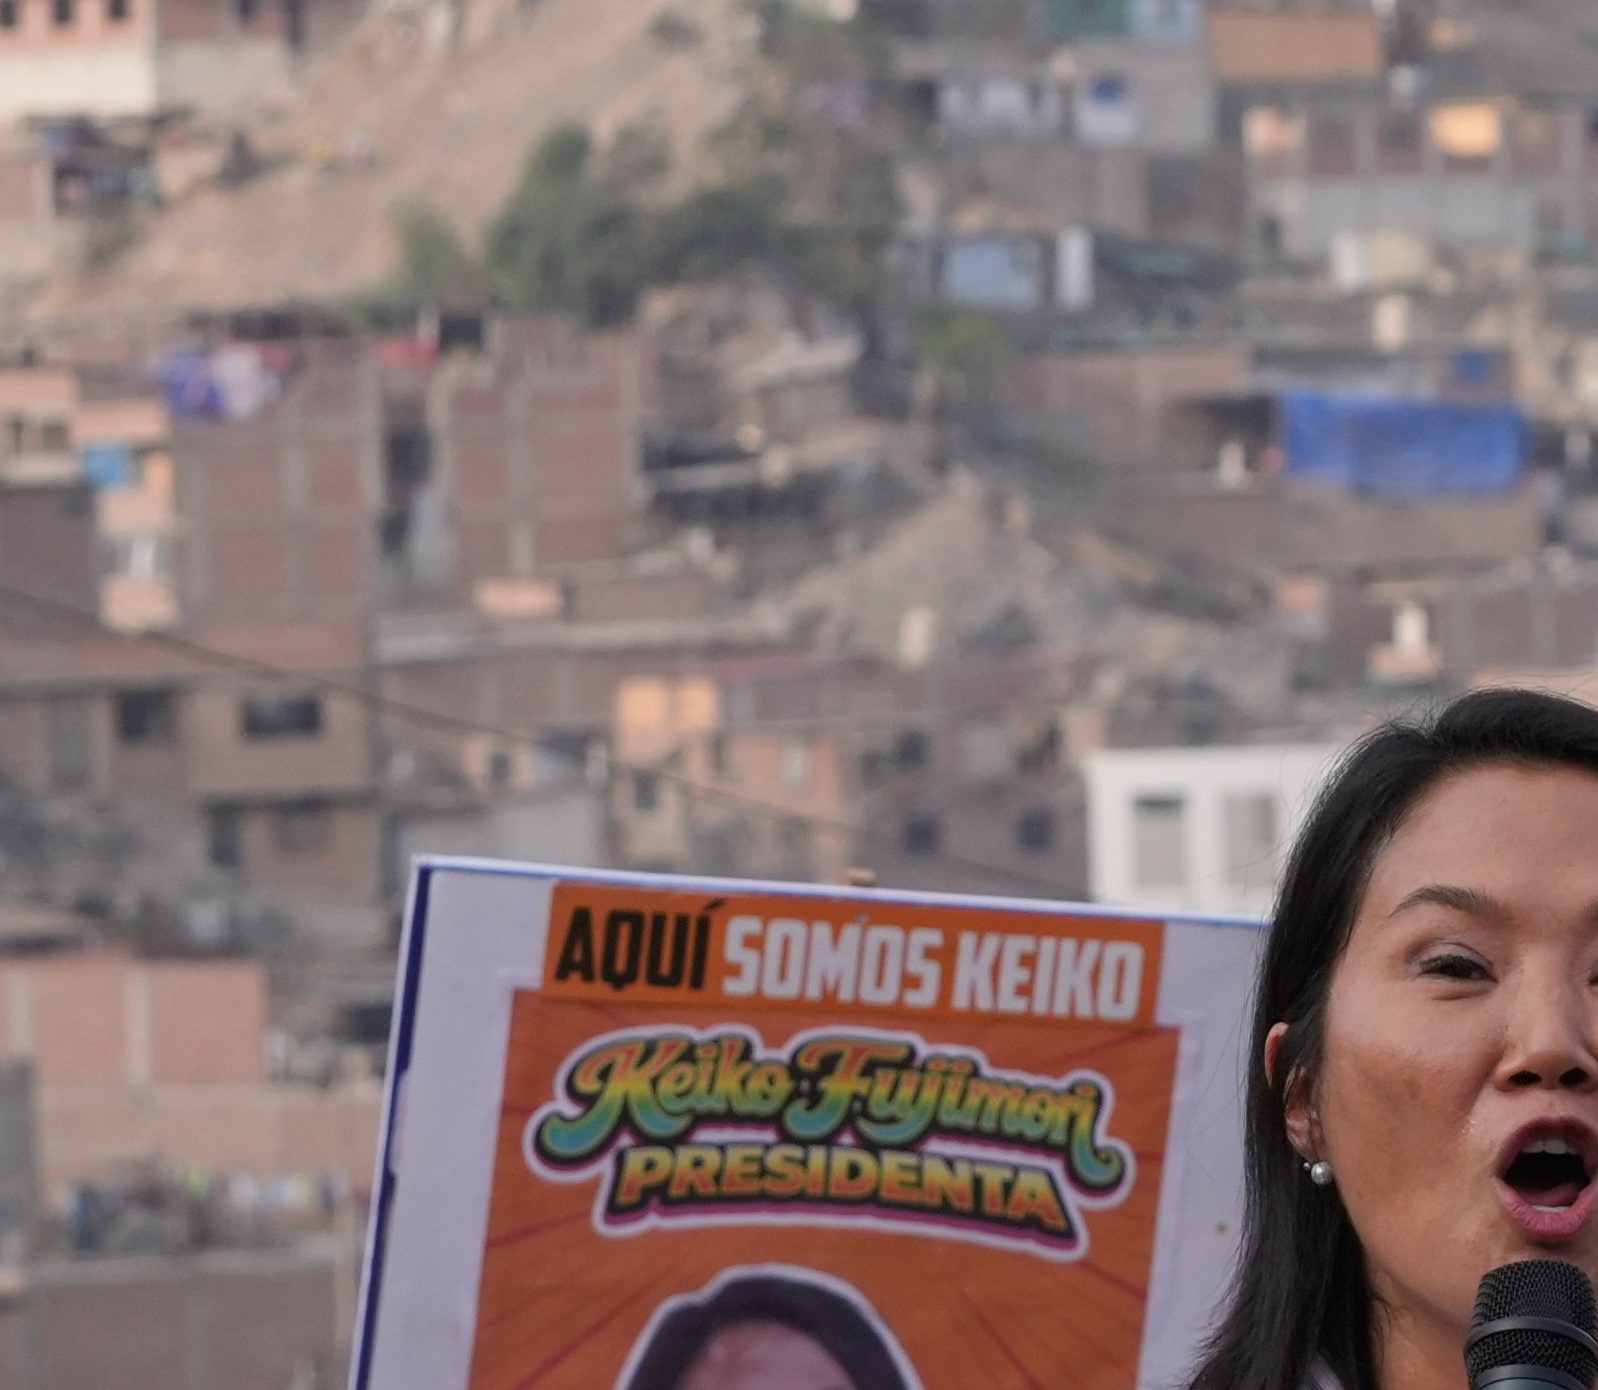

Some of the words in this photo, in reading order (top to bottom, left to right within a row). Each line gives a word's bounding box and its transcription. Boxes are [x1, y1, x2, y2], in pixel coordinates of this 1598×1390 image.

[554, 898, 727, 992] AQUÍ
[723, 914, 944, 1010] SOMOS
[951, 931, 1146, 1023] KEIKO
[541, 1038, 794, 1157] Keiko
[783, 1038, 1123, 1186] Fujimori
[615, 1146, 1070, 1232] PRESIDENTA
